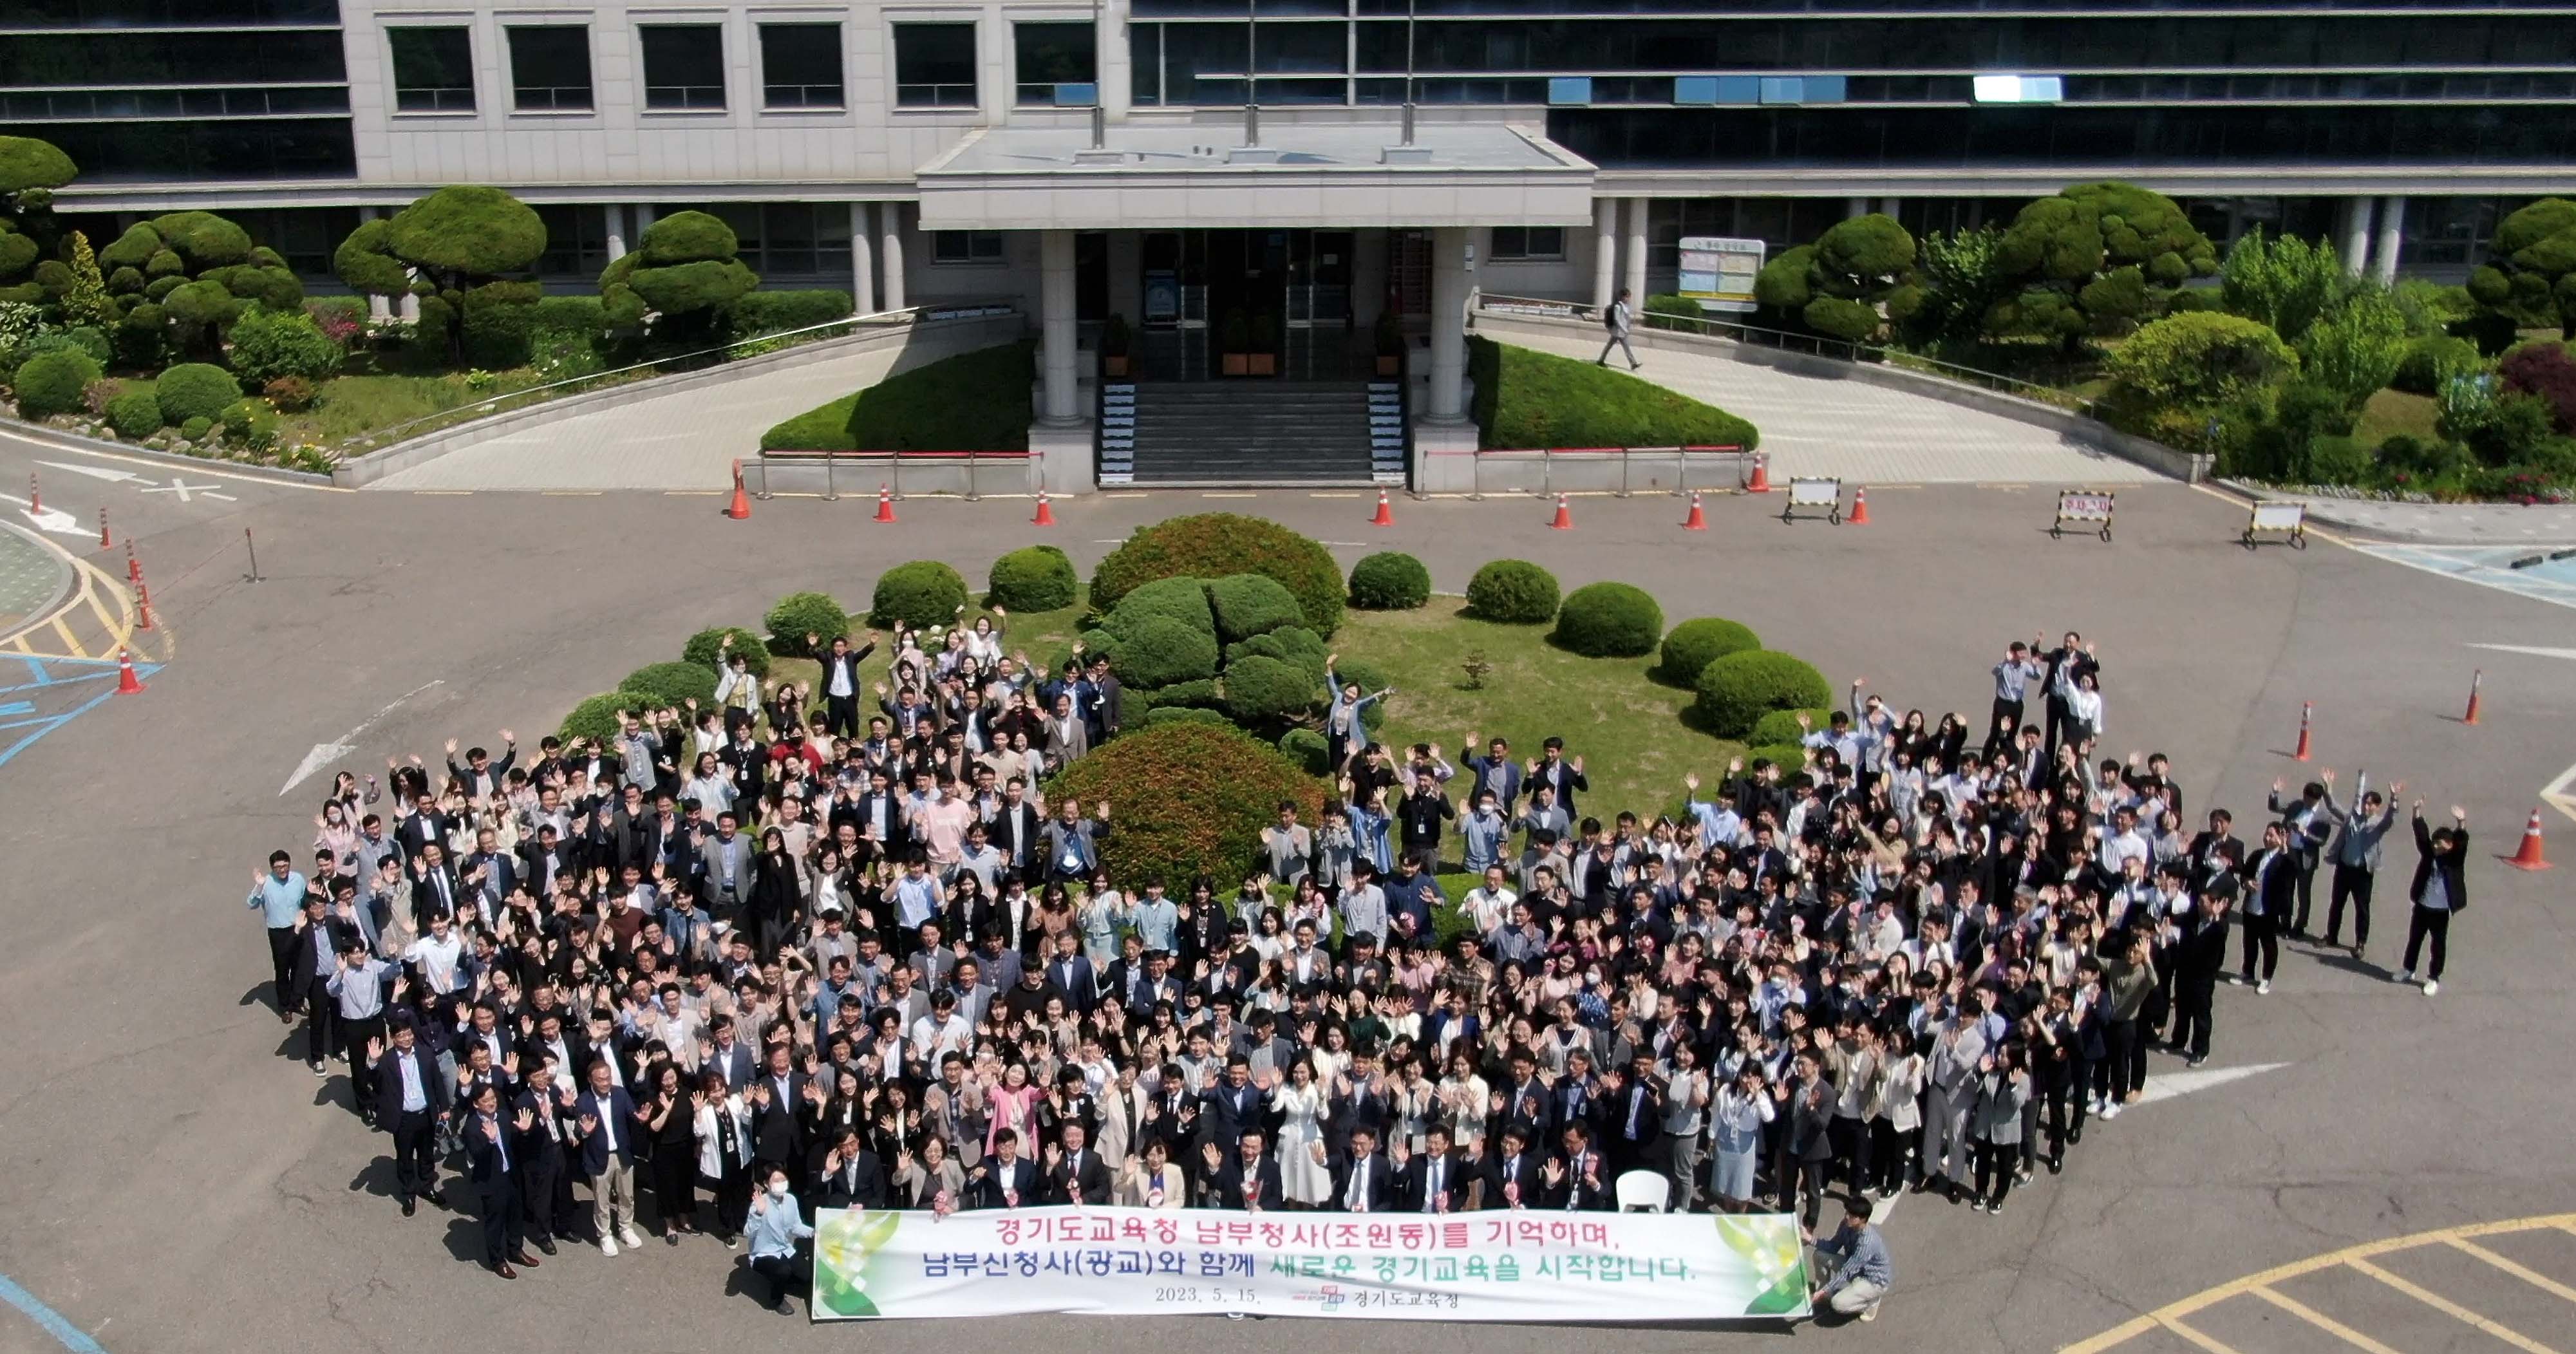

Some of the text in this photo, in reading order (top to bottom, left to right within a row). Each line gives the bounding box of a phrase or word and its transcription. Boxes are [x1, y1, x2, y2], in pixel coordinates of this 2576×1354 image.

[995, 1216, 1619, 1250] 경기도교육청 남부청사(조원동)를 기억하며,
[923, 1249, 1696, 1283] 남부신청사(광교)와 함께 새로운 경기교육을 시작합니다.
[1156, 1286, 1261, 1304] 2023. 5. 15.
